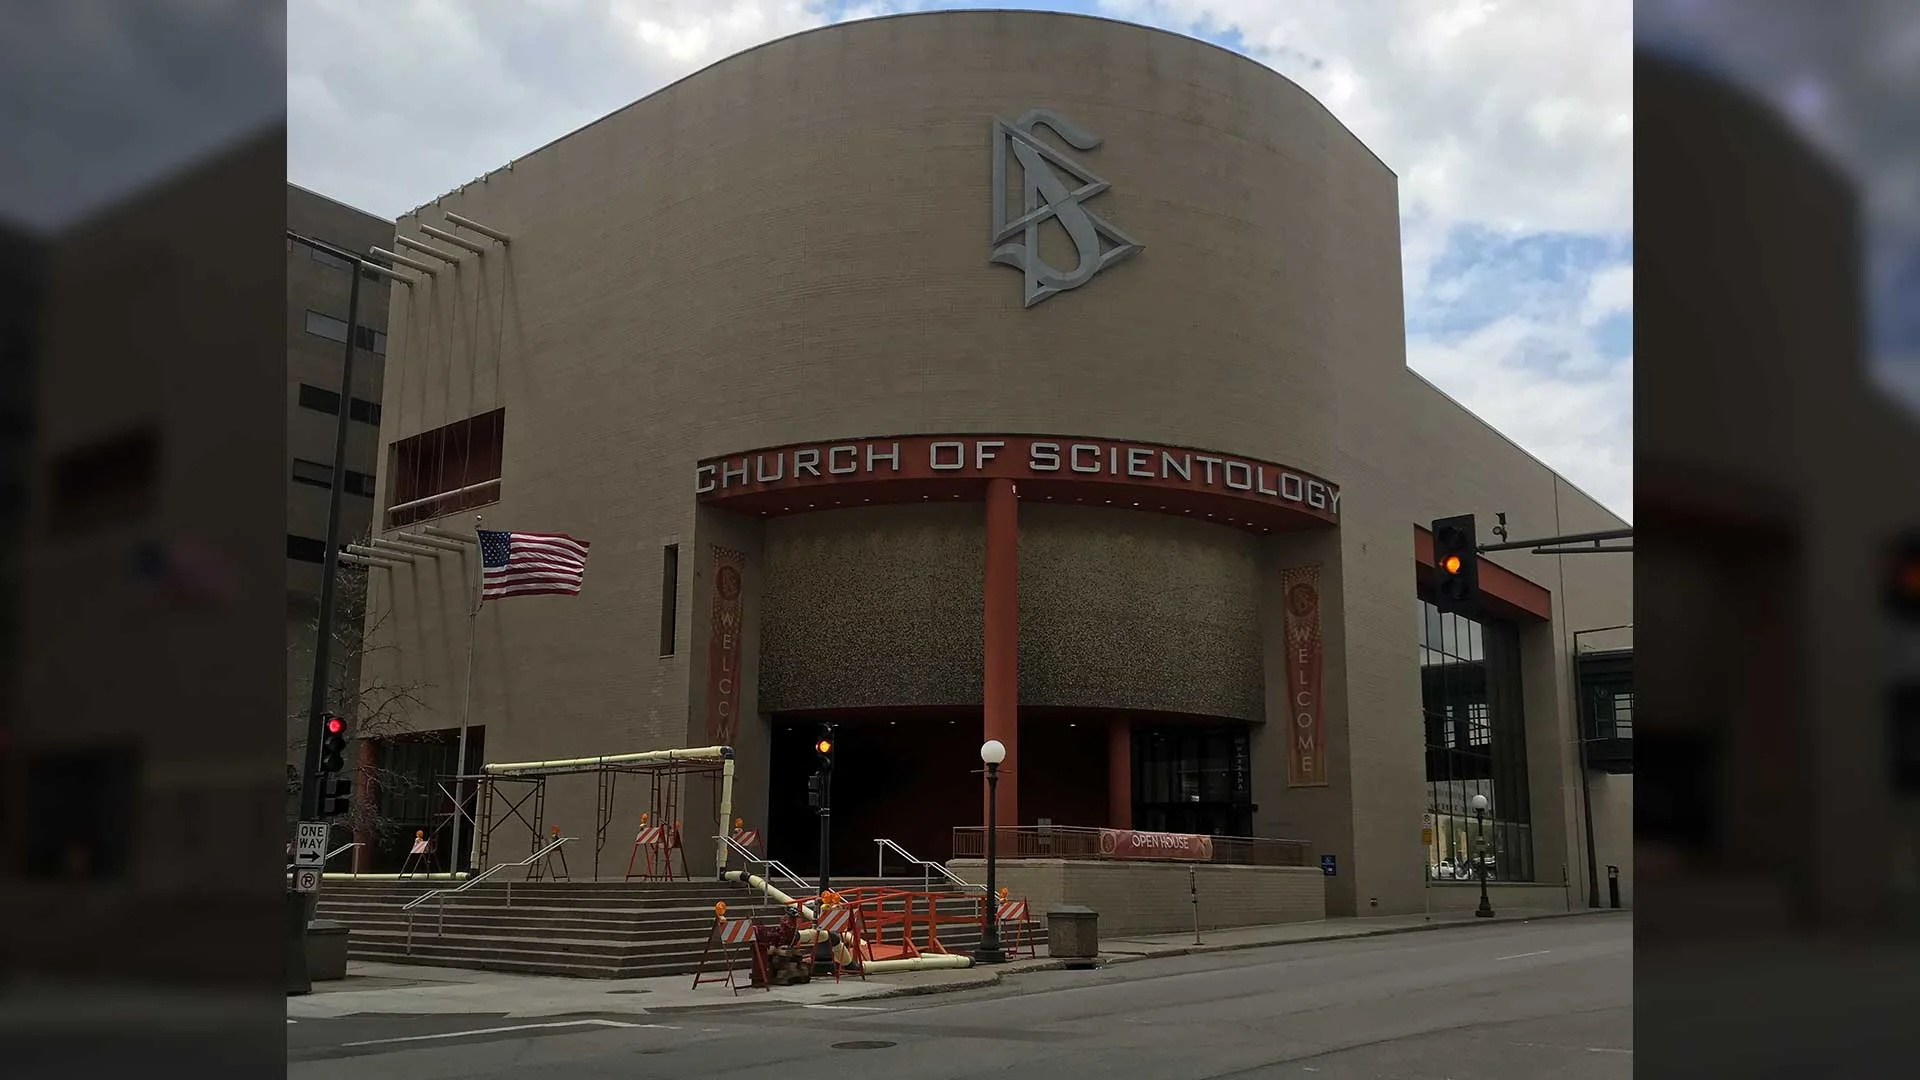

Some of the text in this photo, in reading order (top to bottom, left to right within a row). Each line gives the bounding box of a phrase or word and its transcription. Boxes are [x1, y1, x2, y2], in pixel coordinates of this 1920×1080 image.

[696, 441, 1341, 514] CHURCH OF SCIENTOLOGY
[716, 611, 734, 739] WELCOM
[1294, 627, 1314, 772] WELCOME
[300, 839, 324, 849] WAY
[301, 826, 324, 837] ONE
[1132, 834, 1189, 849] OPEN HOUSE
